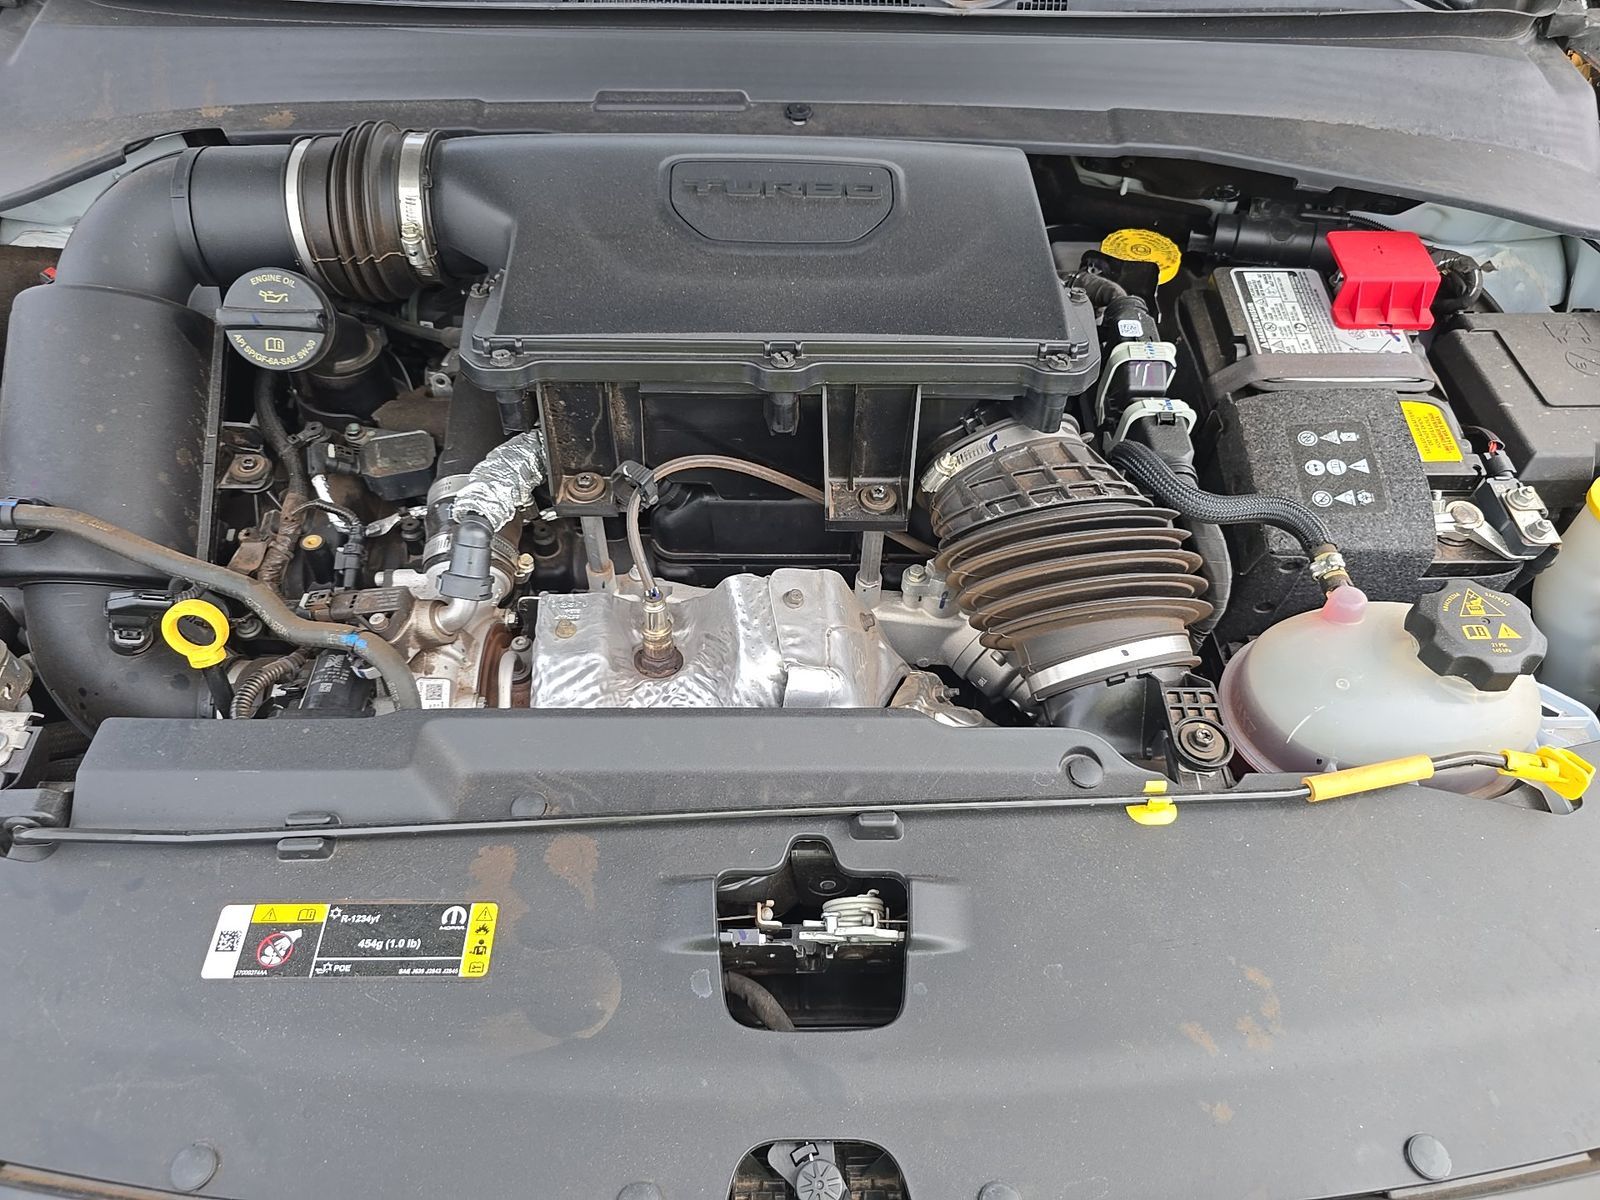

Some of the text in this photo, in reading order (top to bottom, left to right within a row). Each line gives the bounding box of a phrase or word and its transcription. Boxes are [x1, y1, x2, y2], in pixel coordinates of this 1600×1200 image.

[683, 178, 882, 200] TURBO
[250, 274, 296, 288] ENGINE OIL
[233, 334, 247, 348] API
[340, 914, 381, 925] R-1234yf
[357, 938, 421, 951] 454g (1.0 lb)
[333, 963, 352, 973] POE
